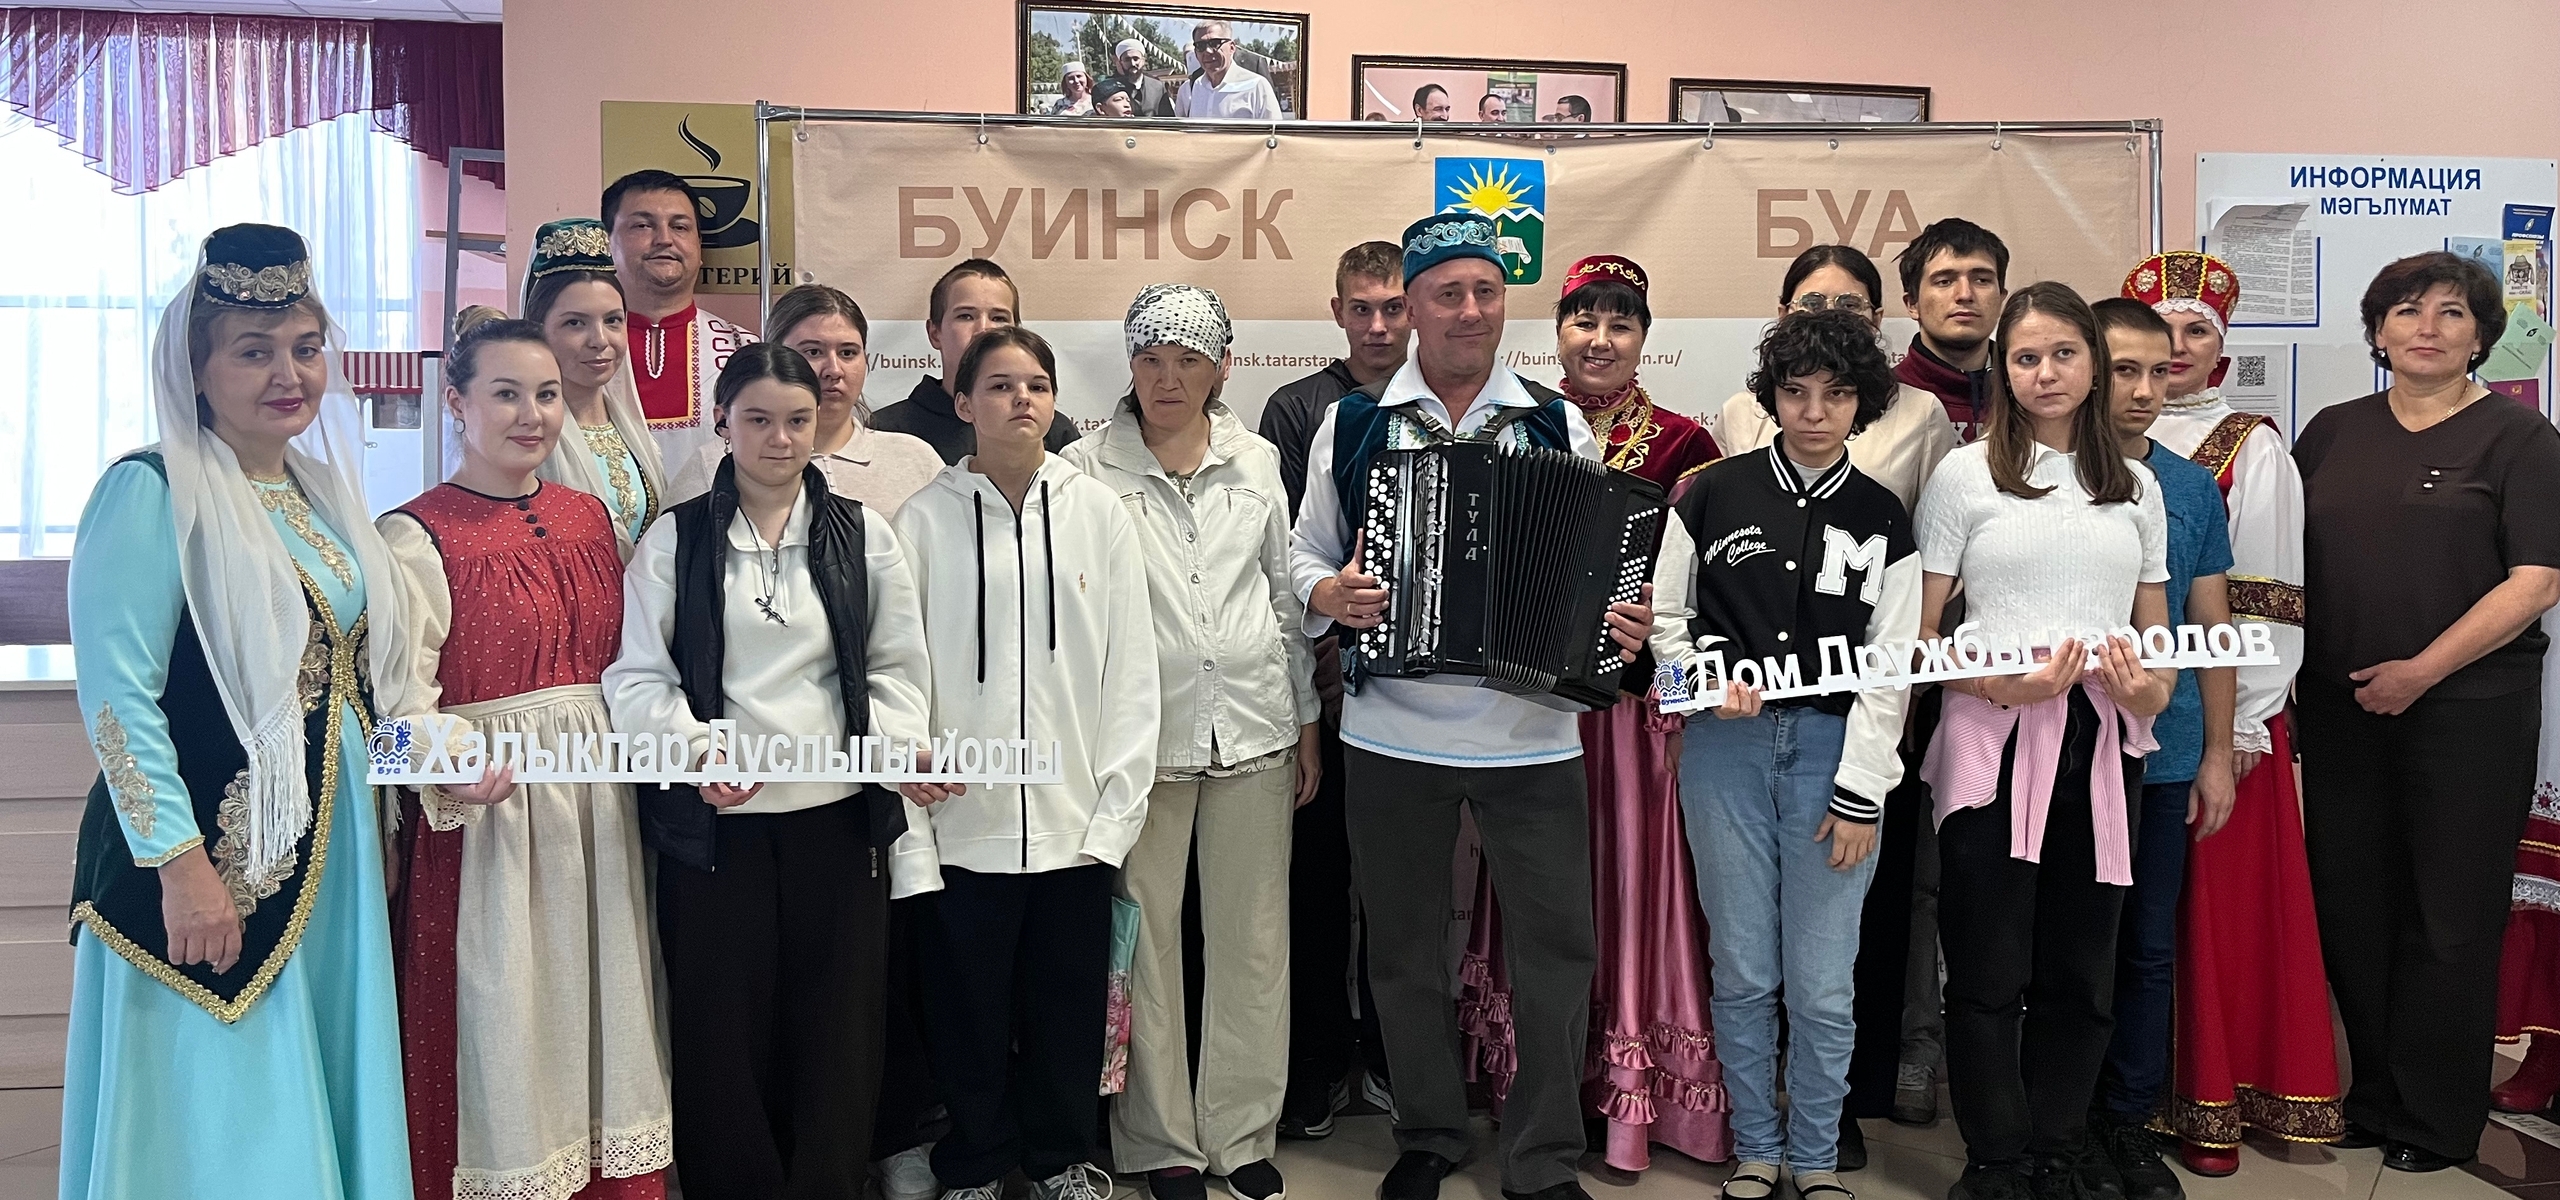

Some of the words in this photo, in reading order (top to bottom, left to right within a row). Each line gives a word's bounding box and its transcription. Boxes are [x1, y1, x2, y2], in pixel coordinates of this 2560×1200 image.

[2291, 166, 2481, 194] ИНФОРМАЦИЯ
[898, 186, 1294, 261] БУИНСК
[1757, 189, 1923, 258] БУА
[1465, 493, 1480, 561] ТУЛА
[1704, 524, 1763, 565] Minnesota
[1726, 540, 1767, 564] College
[1815, 523, 1889, 608] M
[1694, 650, 1804, 710] Дом
[1818, 620, 2034, 696] Дружбы
[419, 716, 690, 791] Халыклар
[701, 719, 917, 790] Дуслыгы
[931, 728, 1062, 789] йорты
